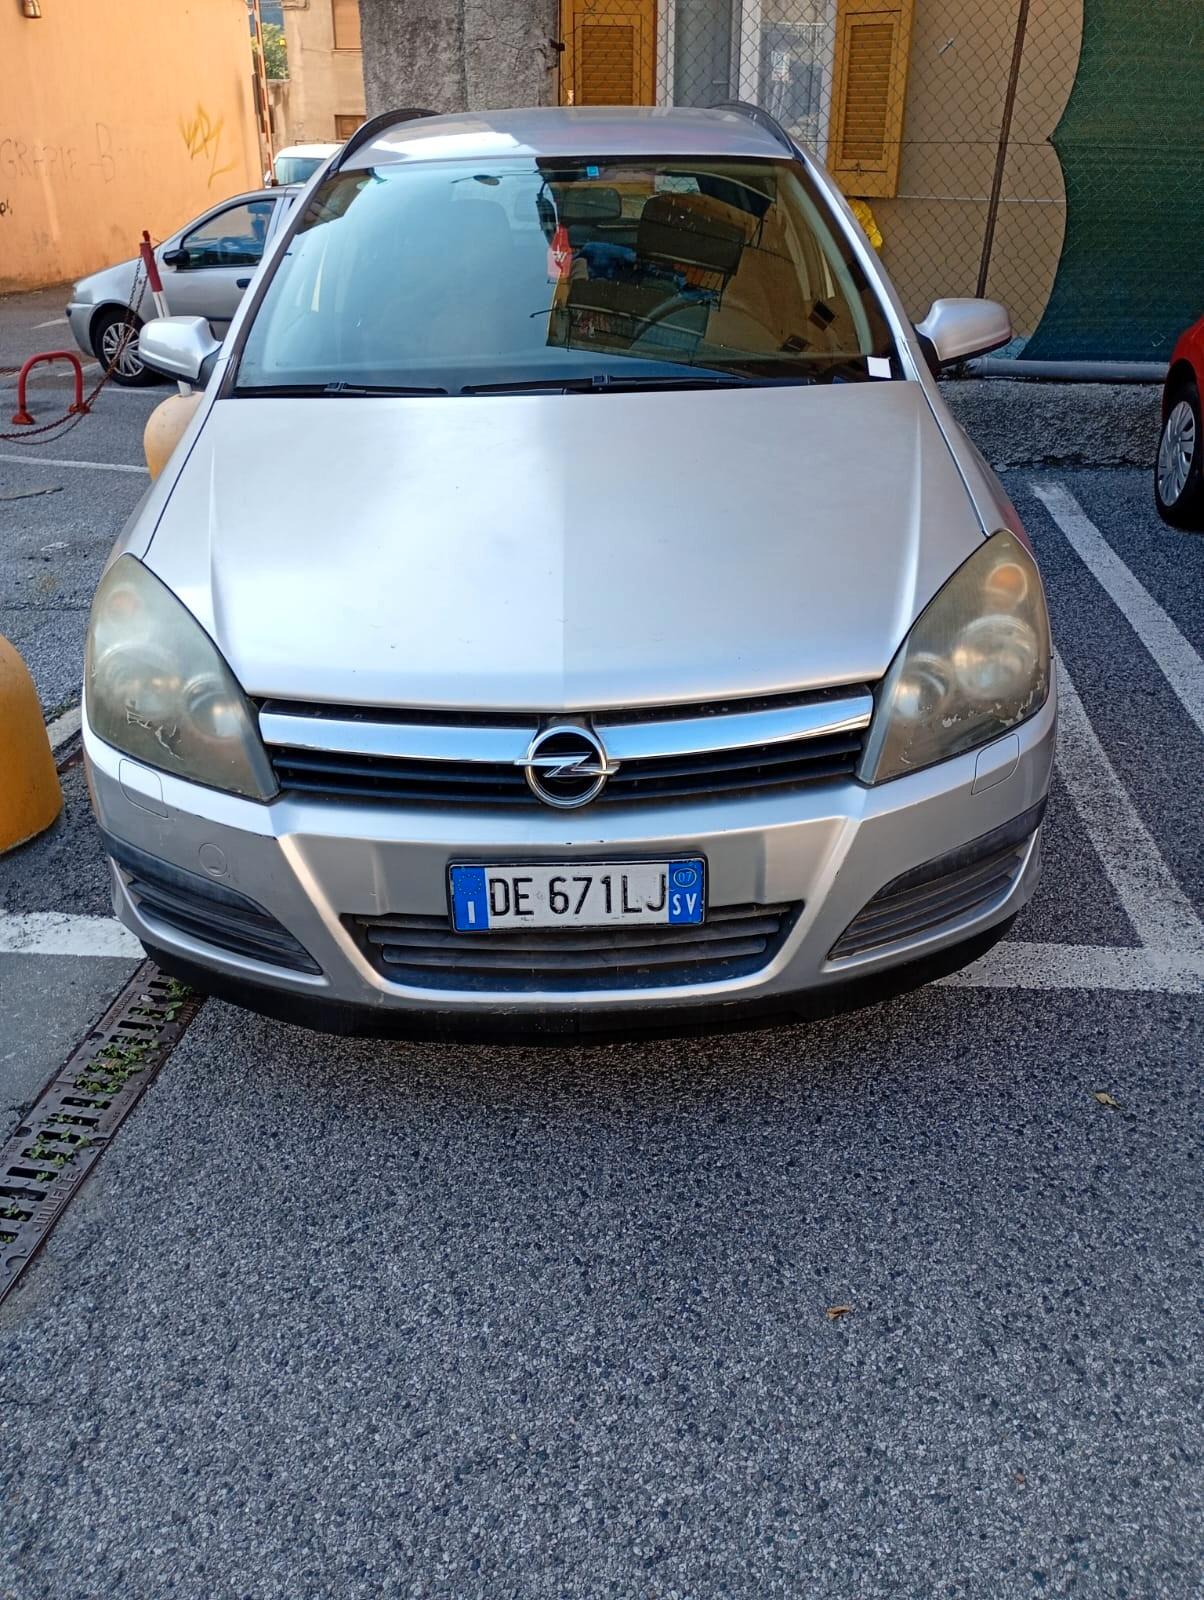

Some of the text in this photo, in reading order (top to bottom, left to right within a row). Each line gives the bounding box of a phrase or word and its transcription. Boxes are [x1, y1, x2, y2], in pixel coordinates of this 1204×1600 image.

[678, 871, 692, 882] 07
[488, 873, 666, 917] DE 671LJ
[672, 893, 697, 916] SV
[467, 901, 476, 924] I
